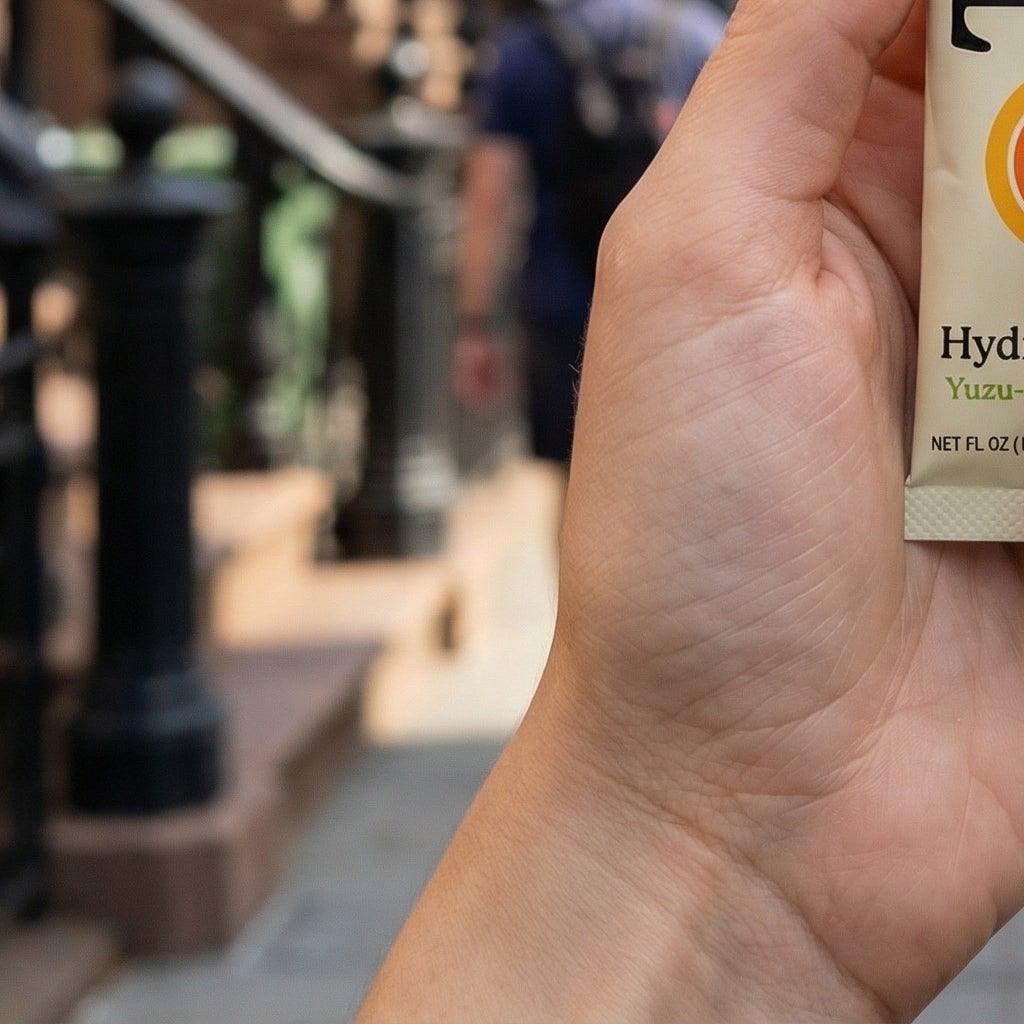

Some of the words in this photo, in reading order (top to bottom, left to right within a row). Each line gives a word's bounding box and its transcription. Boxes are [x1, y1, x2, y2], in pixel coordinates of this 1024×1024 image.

[932, 436, 961, 451] NET
[966, 436, 984, 451] FL
[988, 436, 1009, 451] OZ
